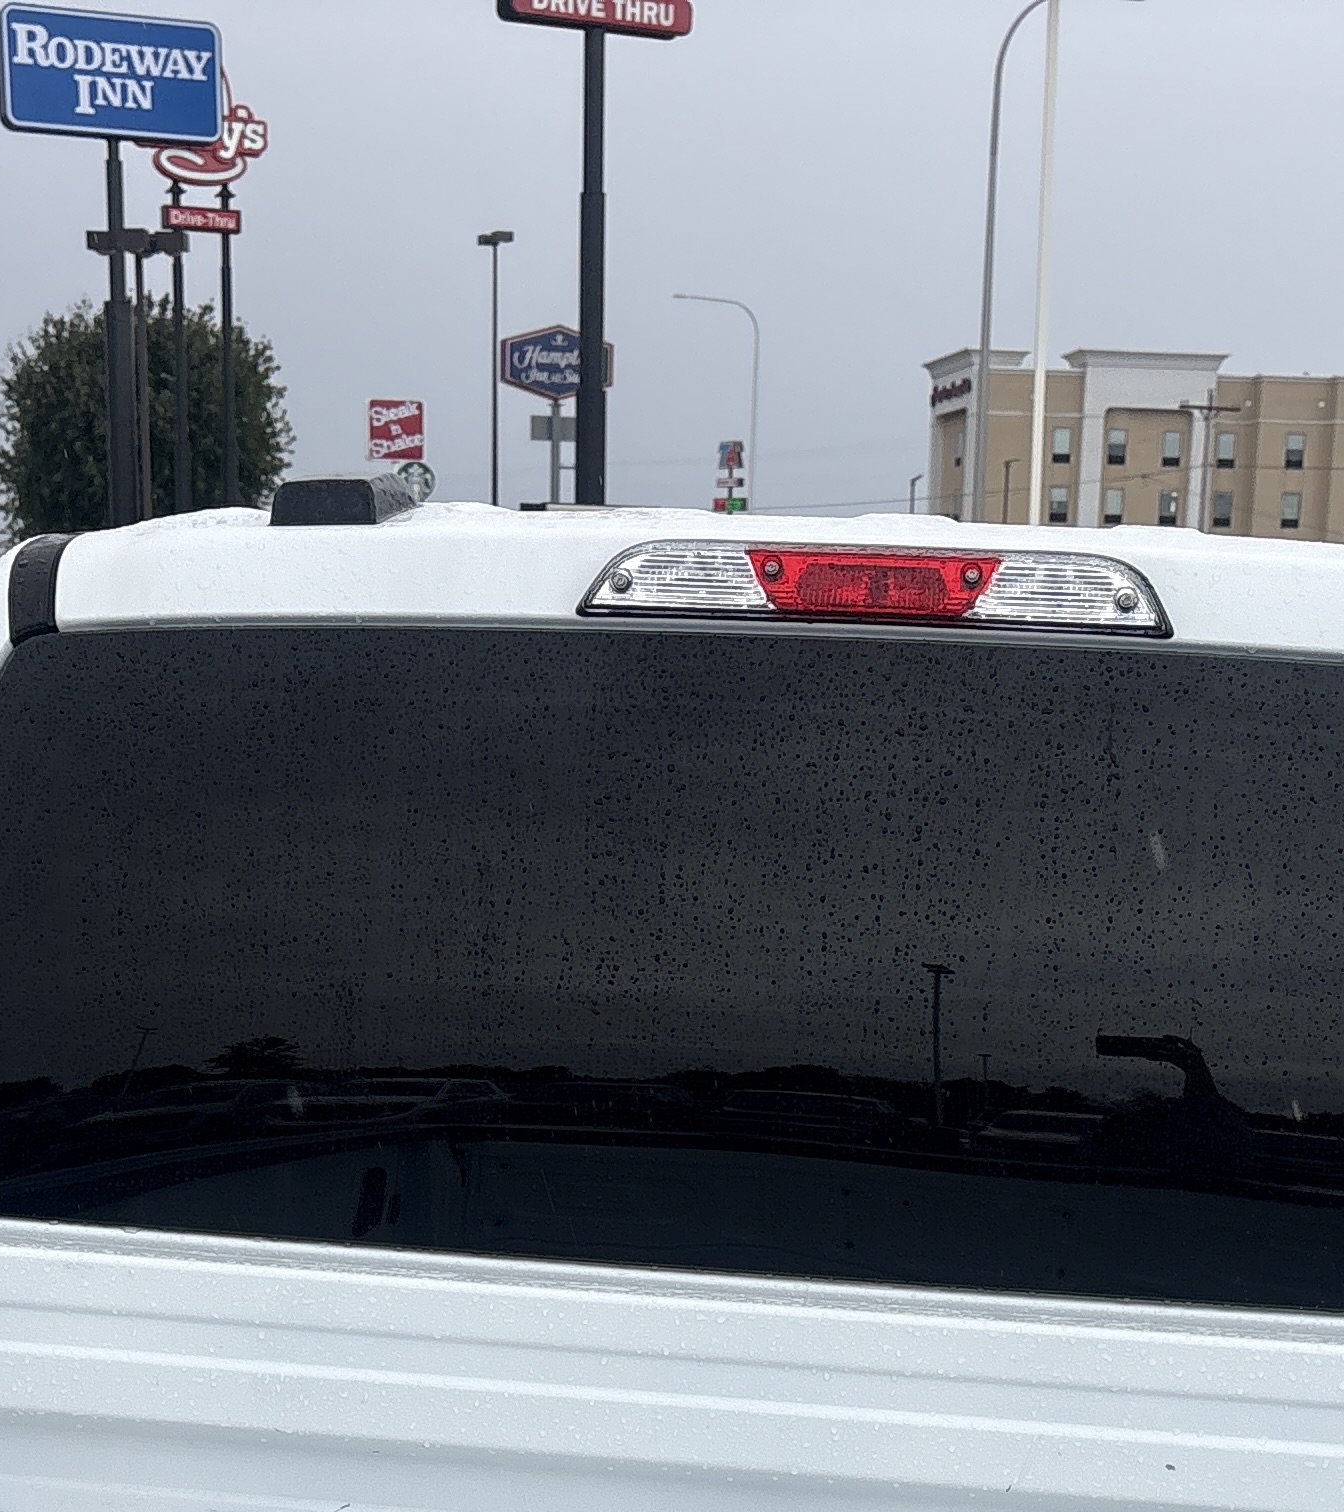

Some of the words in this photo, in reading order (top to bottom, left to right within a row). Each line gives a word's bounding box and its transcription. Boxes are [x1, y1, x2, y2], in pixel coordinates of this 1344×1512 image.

[532, 0, 606, 18] DRIVE
[613, 0, 675, 26] THRU
[11, 22, 212, 81] RODEWAY
[74, 74, 154, 115] INN
[513, 344, 580, 368] Hampt
